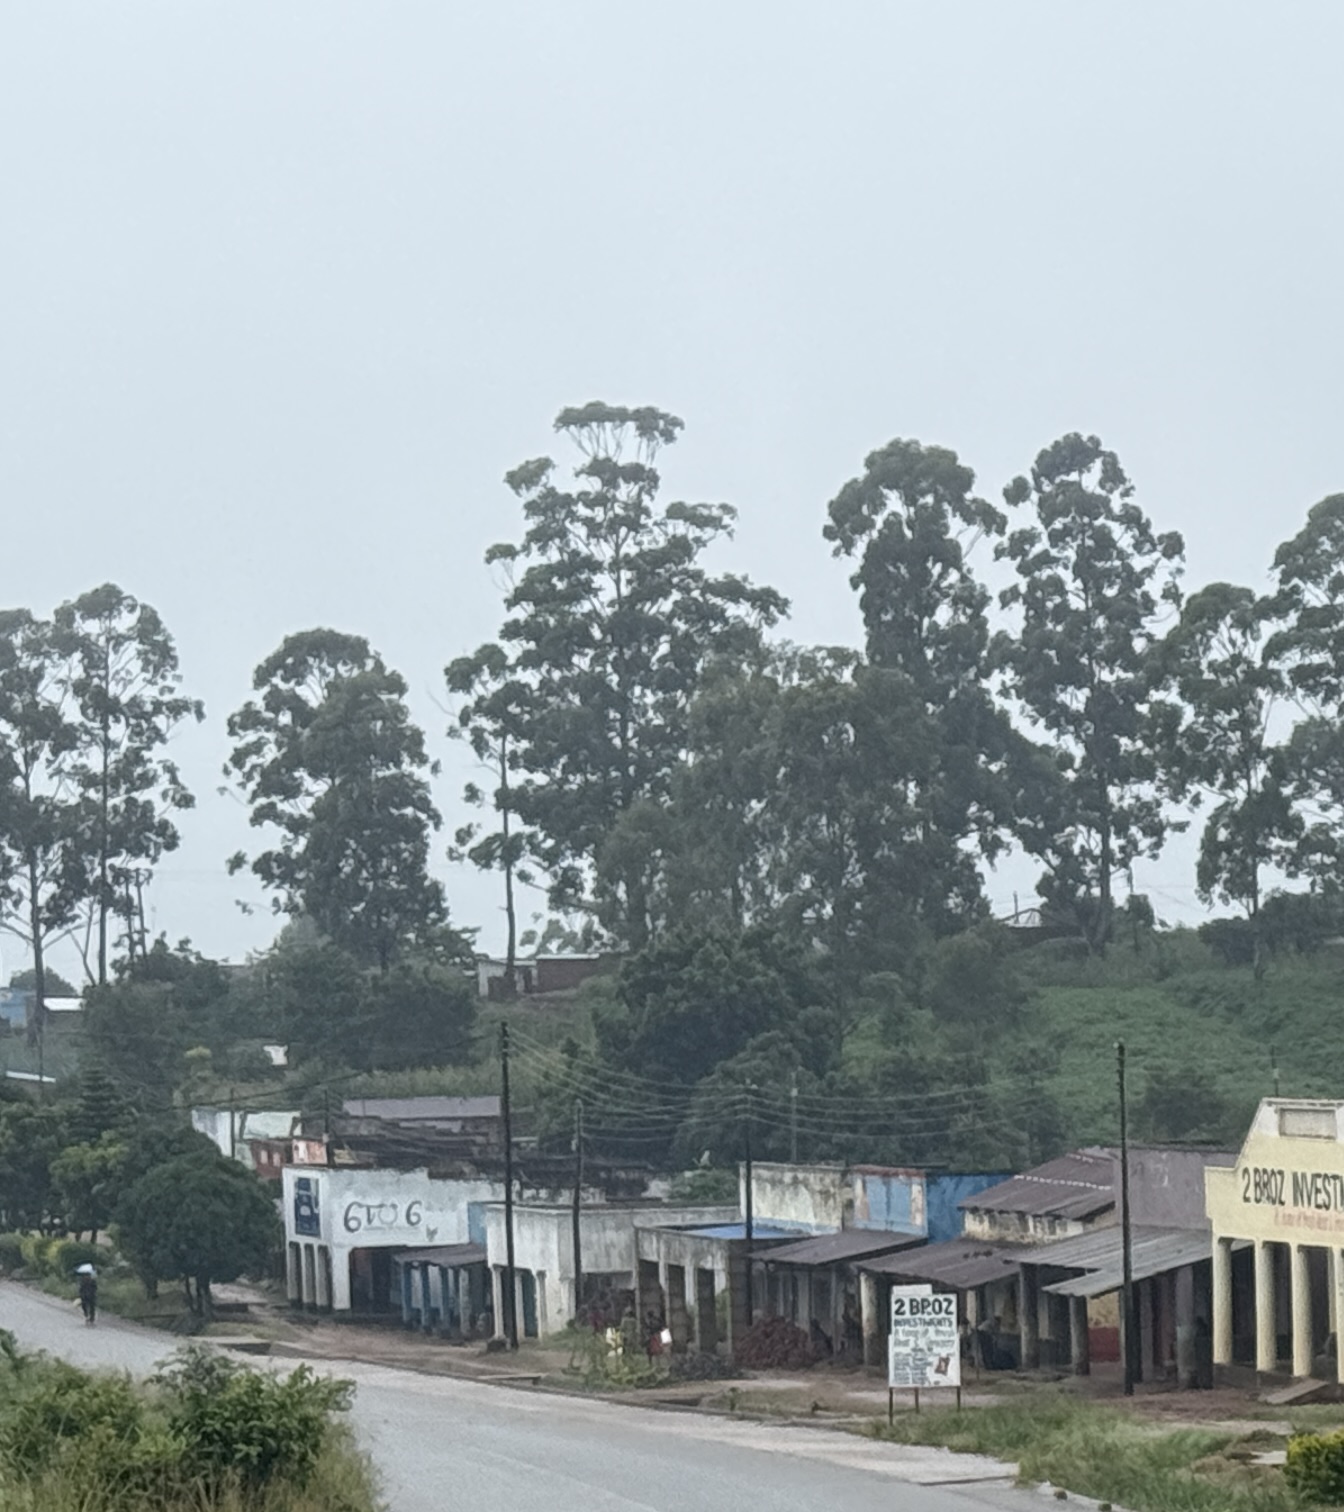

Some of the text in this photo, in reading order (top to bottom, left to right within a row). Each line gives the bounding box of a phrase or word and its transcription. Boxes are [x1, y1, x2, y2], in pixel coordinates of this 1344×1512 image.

[1241, 1166, 1252, 1204] 2
[1252, 1166, 1286, 1206] BROZ
[344, 1201, 362, 1233] 6
[405, 1200, 423, 1226] 6
[894, 1297, 954, 1316] 2 BROZ
